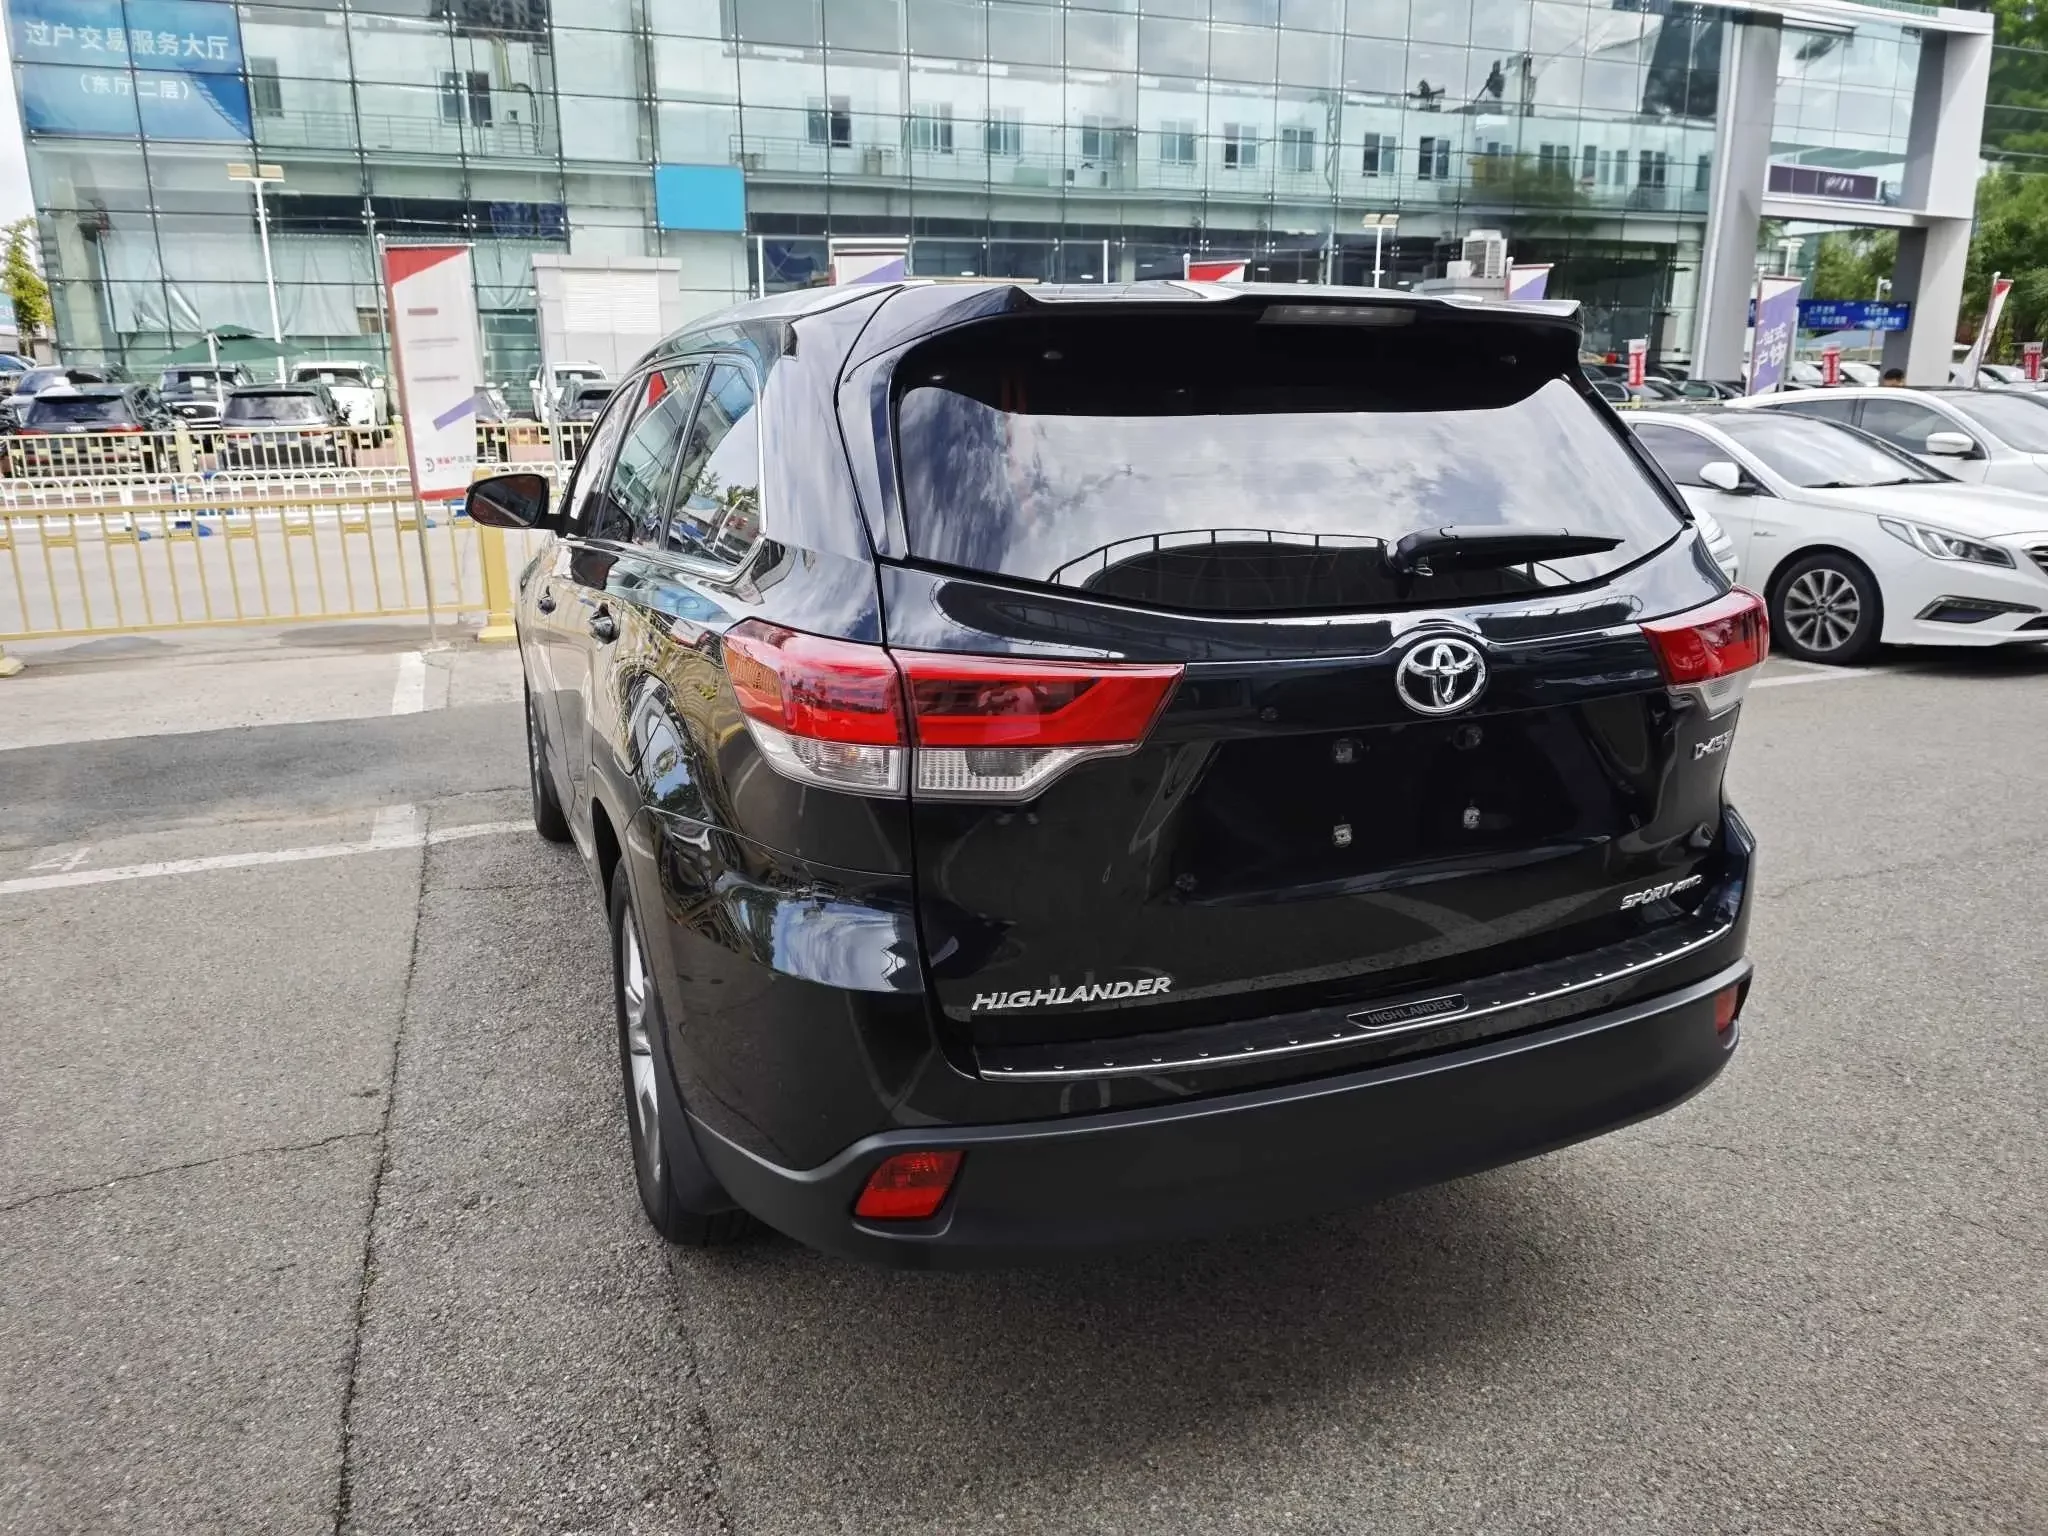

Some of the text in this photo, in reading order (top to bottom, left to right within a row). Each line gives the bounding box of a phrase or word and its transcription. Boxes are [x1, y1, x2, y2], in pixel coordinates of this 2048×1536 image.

[25, 21, 230, 61] 过户交易服务大厅
[1619, 882, 1674, 911] SPORT
[971, 976, 1173, 1012] HIGHLANDER
[1367, 997, 1456, 1025] HIGHLANDER
